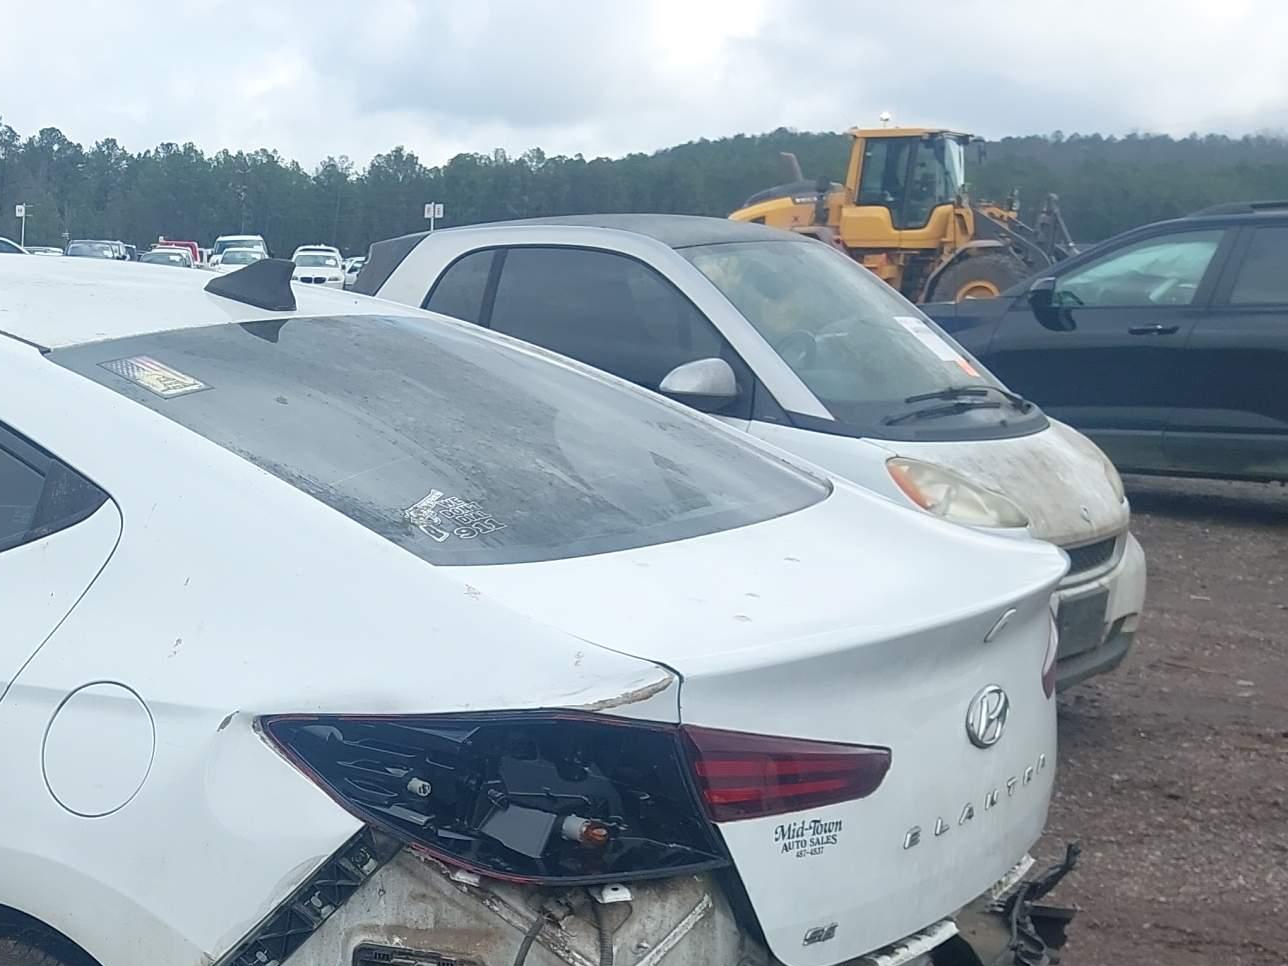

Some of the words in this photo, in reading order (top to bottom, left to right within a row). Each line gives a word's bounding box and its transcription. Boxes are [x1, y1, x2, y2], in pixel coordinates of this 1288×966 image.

[436, 496, 465, 509] WE
[455, 510, 492, 525] DIAL
[453, 518, 508, 539] 911
[904, 753, 1046, 849] ELANTRA
[774, 819, 843, 842] Mid-Town
[781, 839, 808, 854] AUTO
[809, 834, 838, 847] SALES
